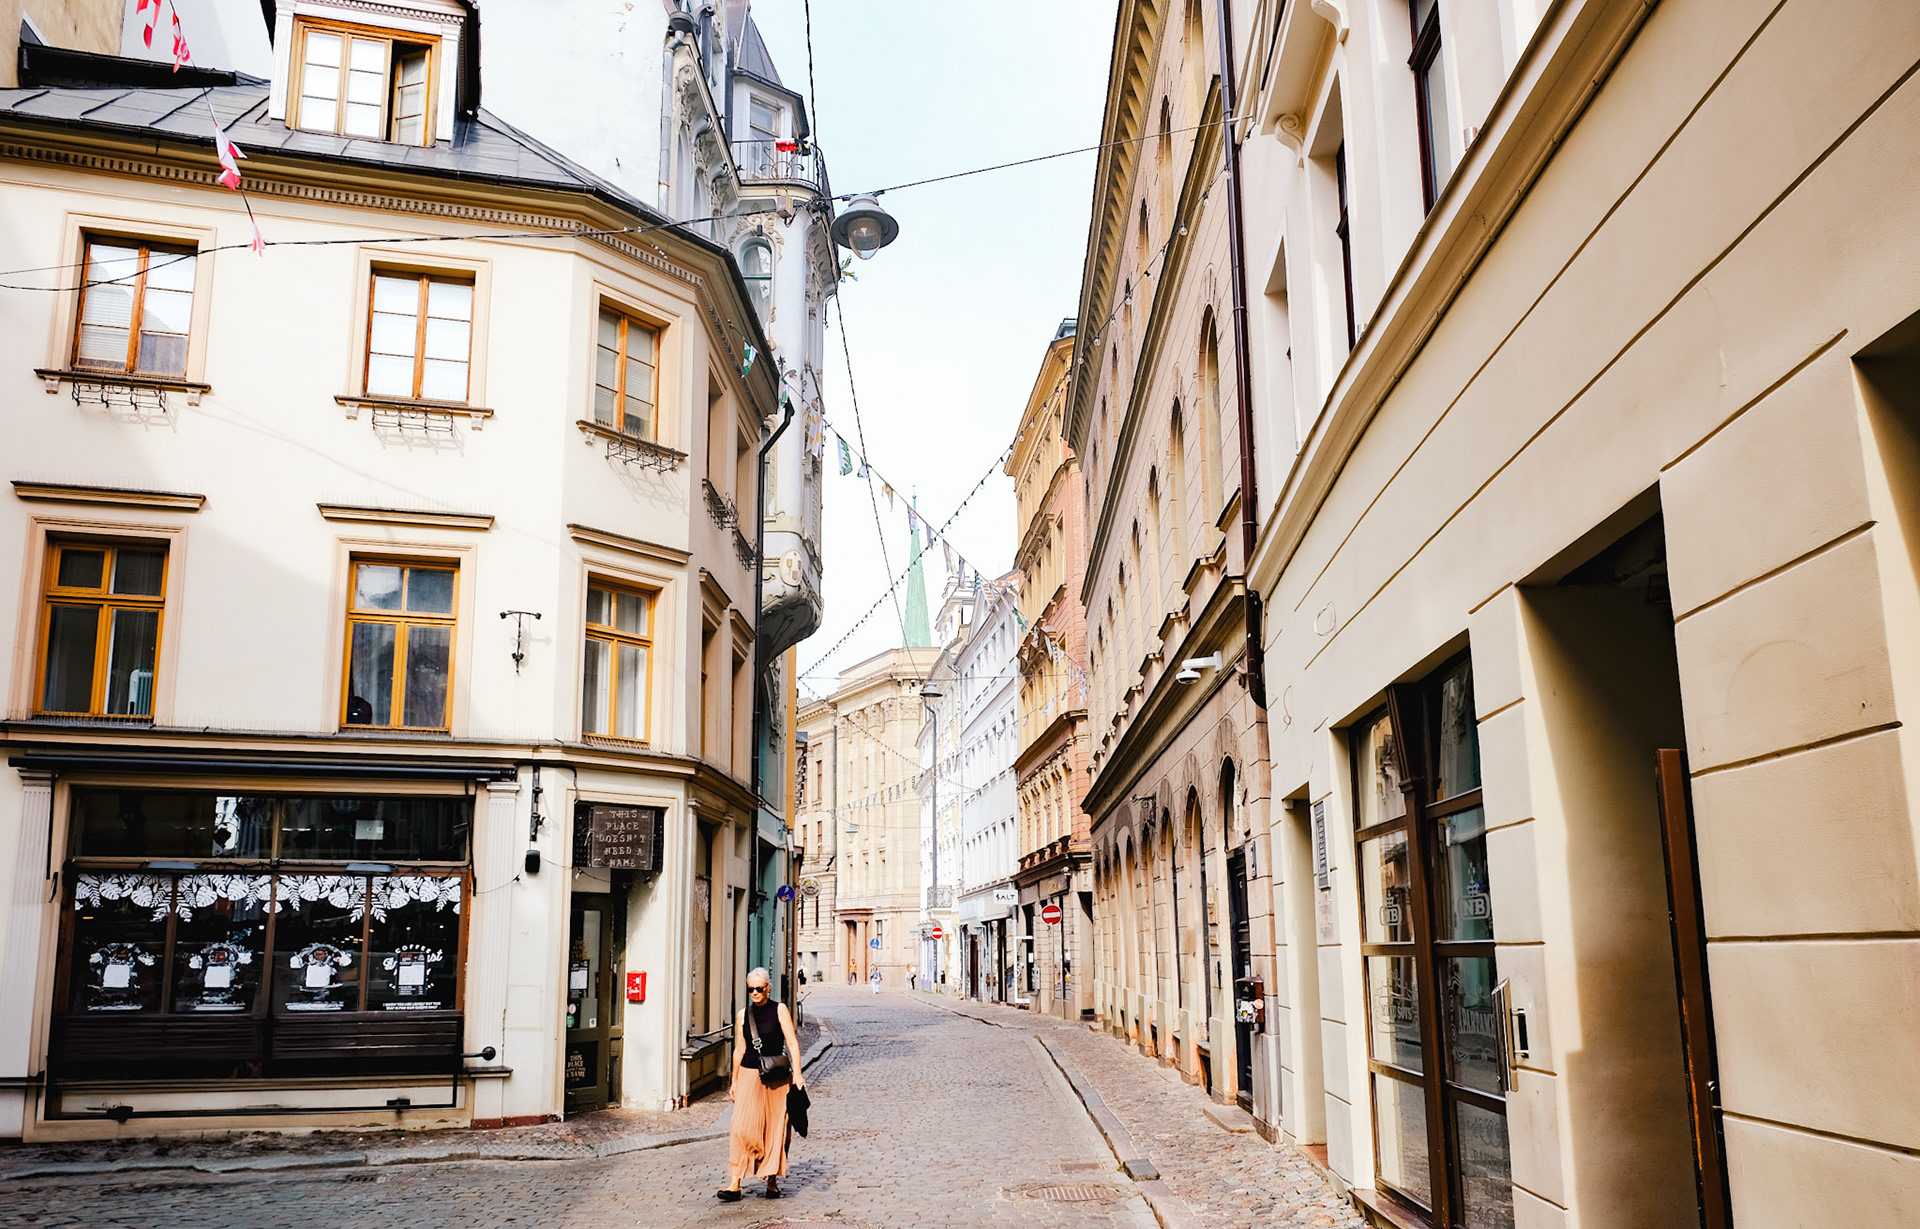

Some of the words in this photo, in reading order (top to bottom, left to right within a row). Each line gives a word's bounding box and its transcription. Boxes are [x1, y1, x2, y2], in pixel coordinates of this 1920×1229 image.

[609, 809, 638, 819] THIS
[605, 821, 639, 831] PLACE
[598, 834, 646, 844] DOESN'T
[604, 846, 632, 856] NEED
[637, 847, 645, 857] A
[609, 858, 636, 867] NAME
[1463, 898, 1486, 916] NB
[395, 944, 432, 954] COFFEE
